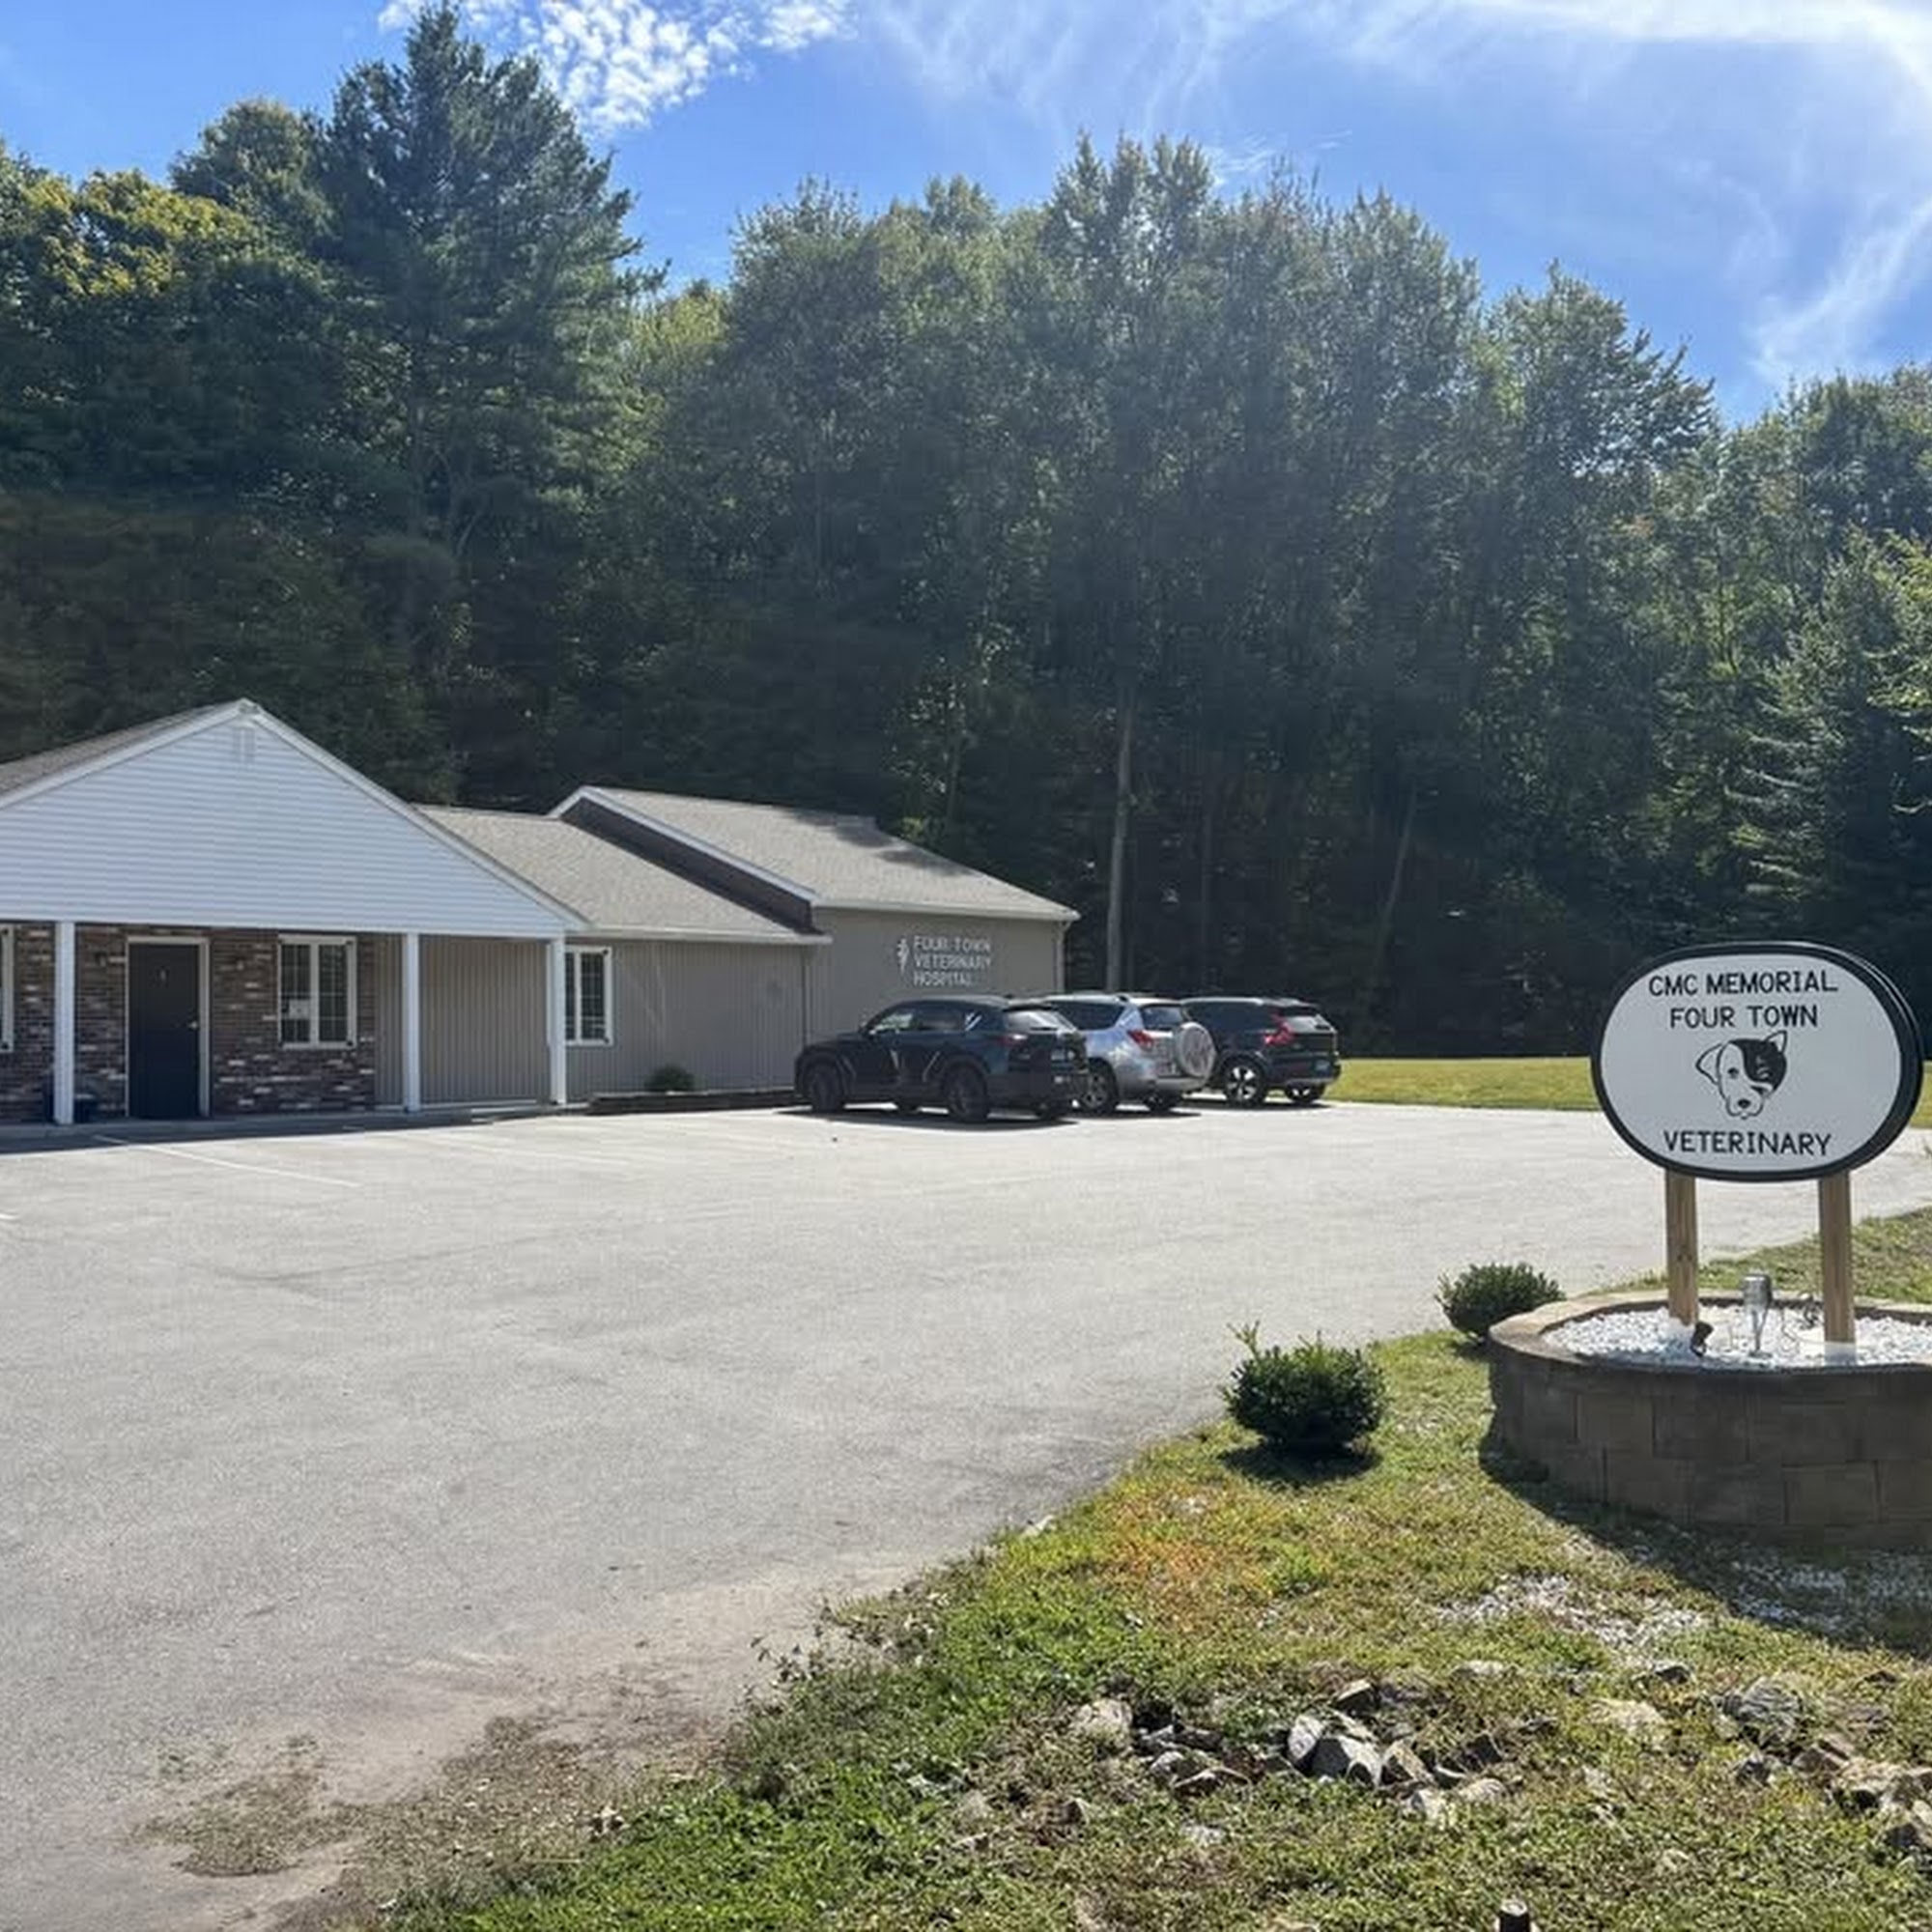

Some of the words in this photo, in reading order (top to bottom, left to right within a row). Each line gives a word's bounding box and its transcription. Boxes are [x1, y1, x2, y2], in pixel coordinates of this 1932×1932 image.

[913, 935, 948, 951] FOUR
[1648, 976, 1697, 996] CMC
[1706, 971, 1838, 994] MEMORIAL
[1669, 1007, 1735, 1029] FOUR
[1747, 1005, 1818, 1027] TOWN
[1663, 1130, 1832, 1155] VETERINARY
